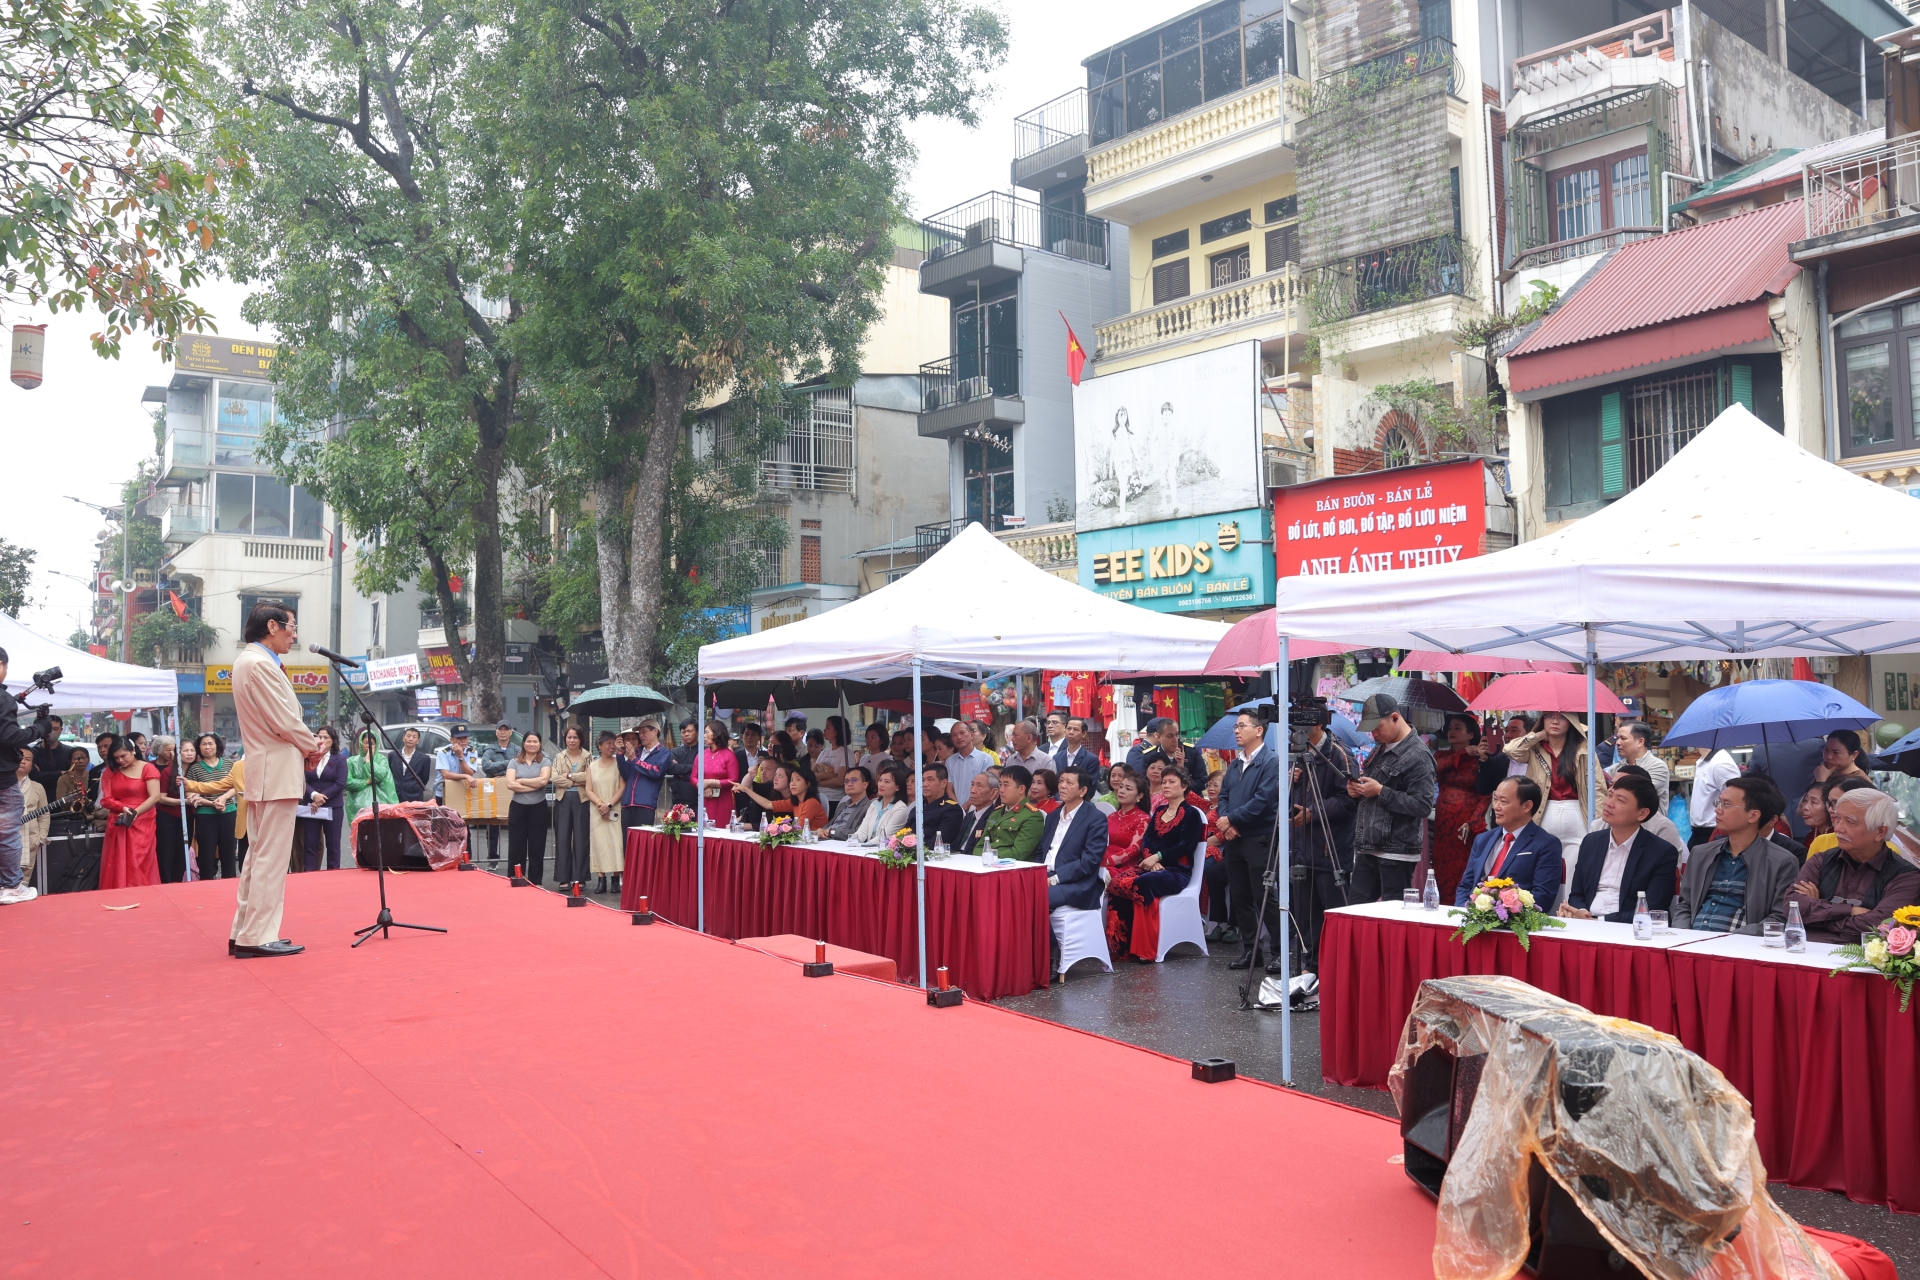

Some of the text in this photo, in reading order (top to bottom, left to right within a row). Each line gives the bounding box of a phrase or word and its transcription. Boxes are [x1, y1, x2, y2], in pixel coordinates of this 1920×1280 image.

[231, 342, 255, 356] ĐÈN
[1195, 363, 1211, 373] NEW
[1195, 365, 1238, 382] COLLECTION
[1316, 495, 1340, 512] BÁN
[1343, 491, 1375, 509] BUÔN
[1386, 486, 1412, 503] BÁN
[1416, 480, 1433, 500] LẺ
[1288, 503, 1467, 541] ĐỒ LÓT, ĐỒ BƠI, ĐỒ TẬP, ĐỒ LƯU NIỆM
[1093, 541, 1213, 584] BEE KIDS
[1299, 534, 1463, 576] ANH ÁNH THỦY
[1136, 586, 1158, 598] BÁN
[1161, 581, 1193, 596] BUÔN
[1206, 580, 1230, 593] BÁN
[428, 655, 442, 668] THU
[369, 666, 398, 681] EXCHANGE
[398, 663, 417, 676] MONEY
[374, 679, 395, 688] TOURIST
